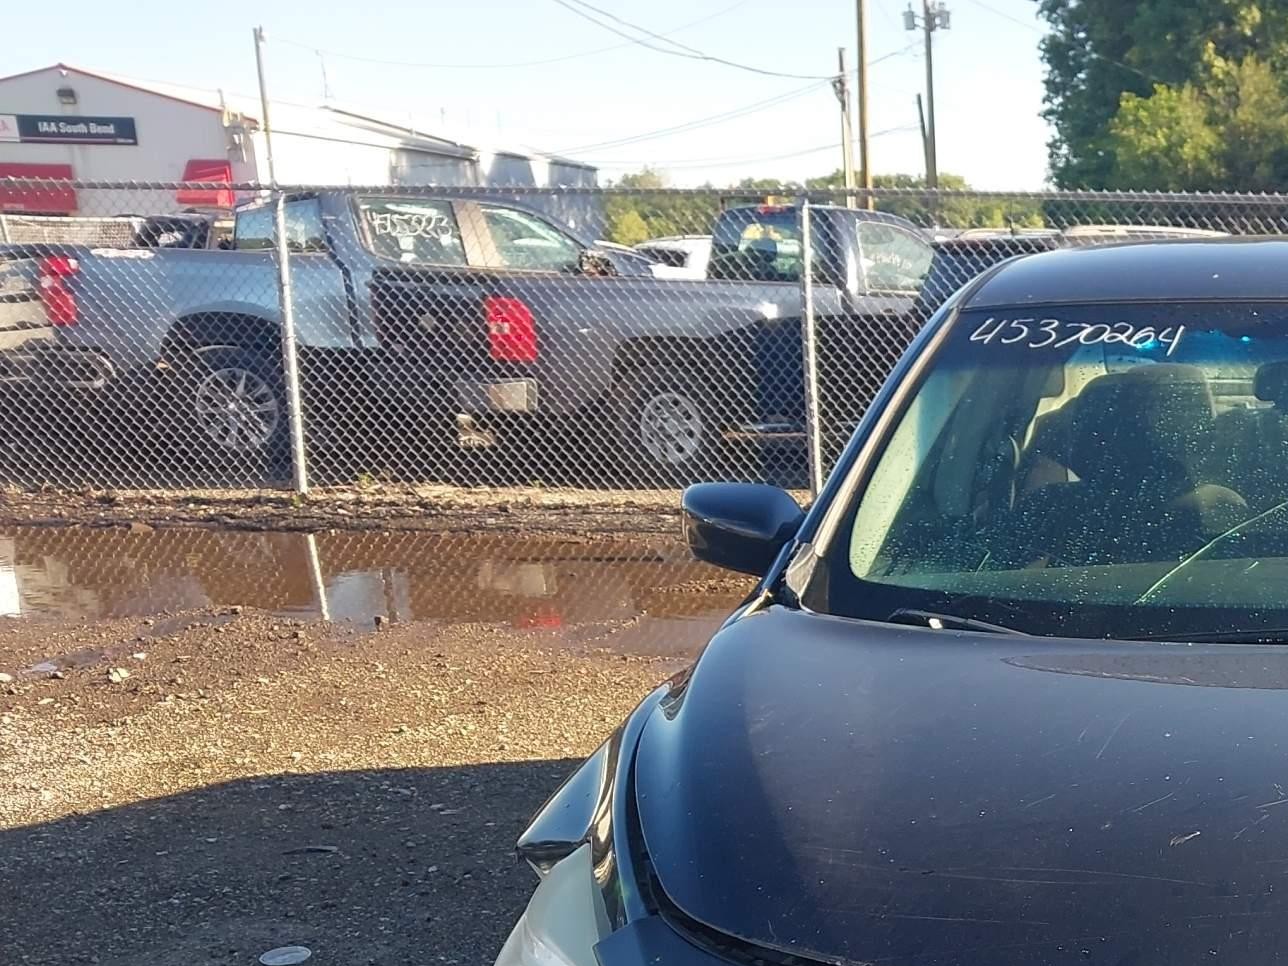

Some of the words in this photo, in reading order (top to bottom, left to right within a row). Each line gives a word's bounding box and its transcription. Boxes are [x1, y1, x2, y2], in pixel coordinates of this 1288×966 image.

[38, 121, 58, 133] IAA
[59, 122, 88, 134] South
[89, 123, 115, 134] Bend
[969, 317, 1186, 357] 45370264
